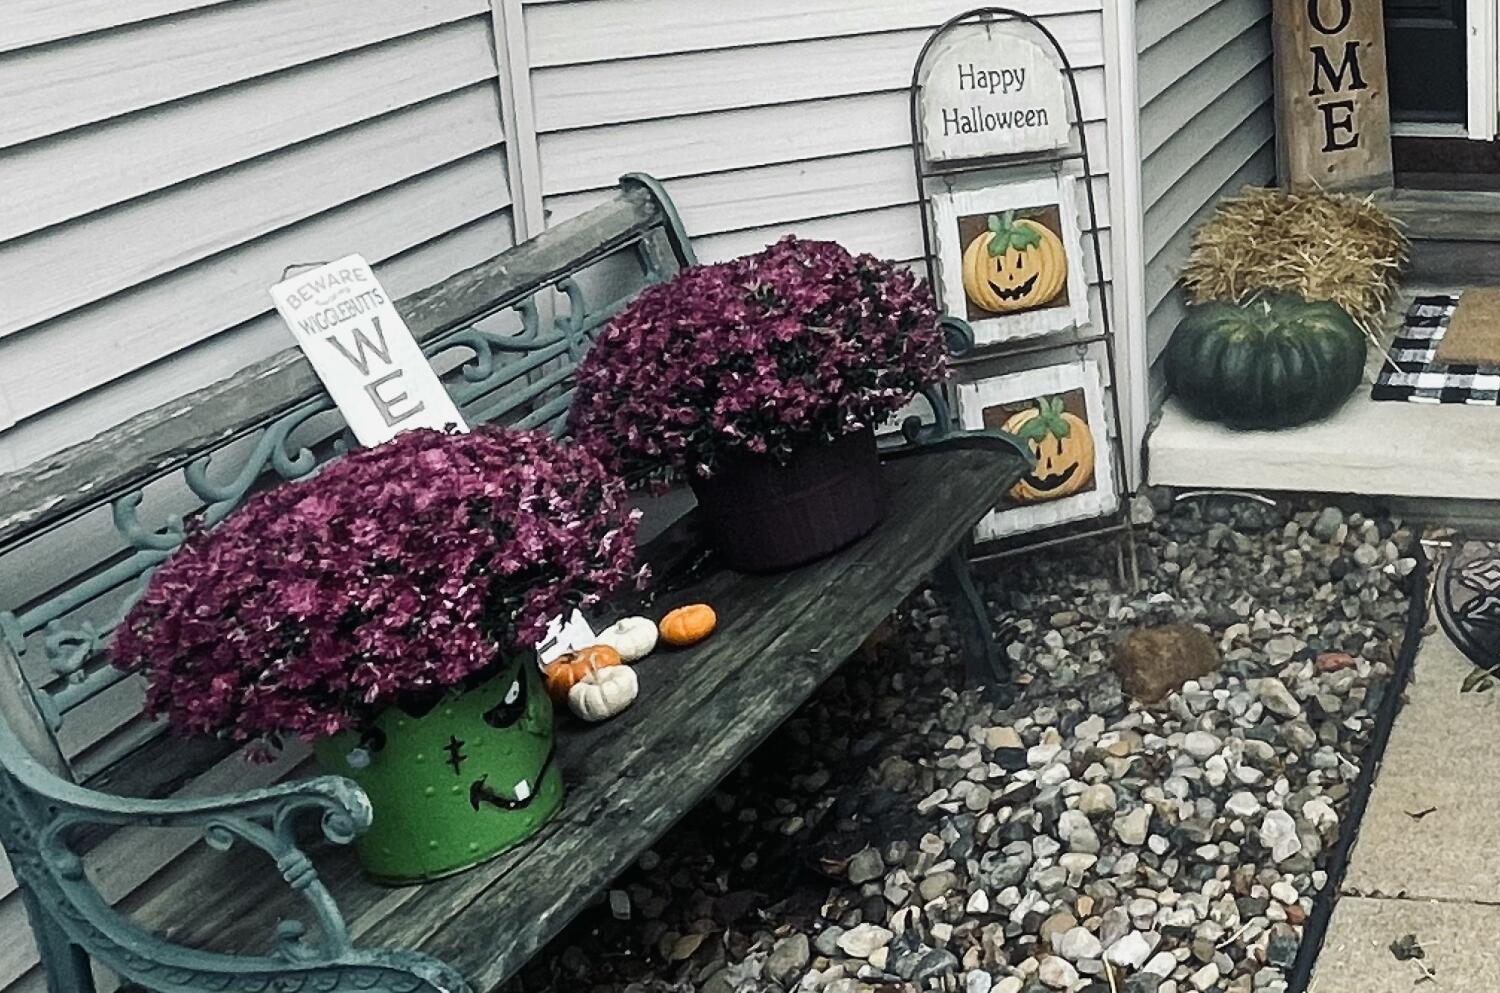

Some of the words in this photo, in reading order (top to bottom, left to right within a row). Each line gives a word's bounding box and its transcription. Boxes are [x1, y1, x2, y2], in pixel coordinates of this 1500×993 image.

[957, 63, 1025, 94] Happy
[942, 105, 1049, 136] Halloween
[285, 267, 368, 311] BEWARE
[297, 287, 385, 336] WIGGLEBUTTS
